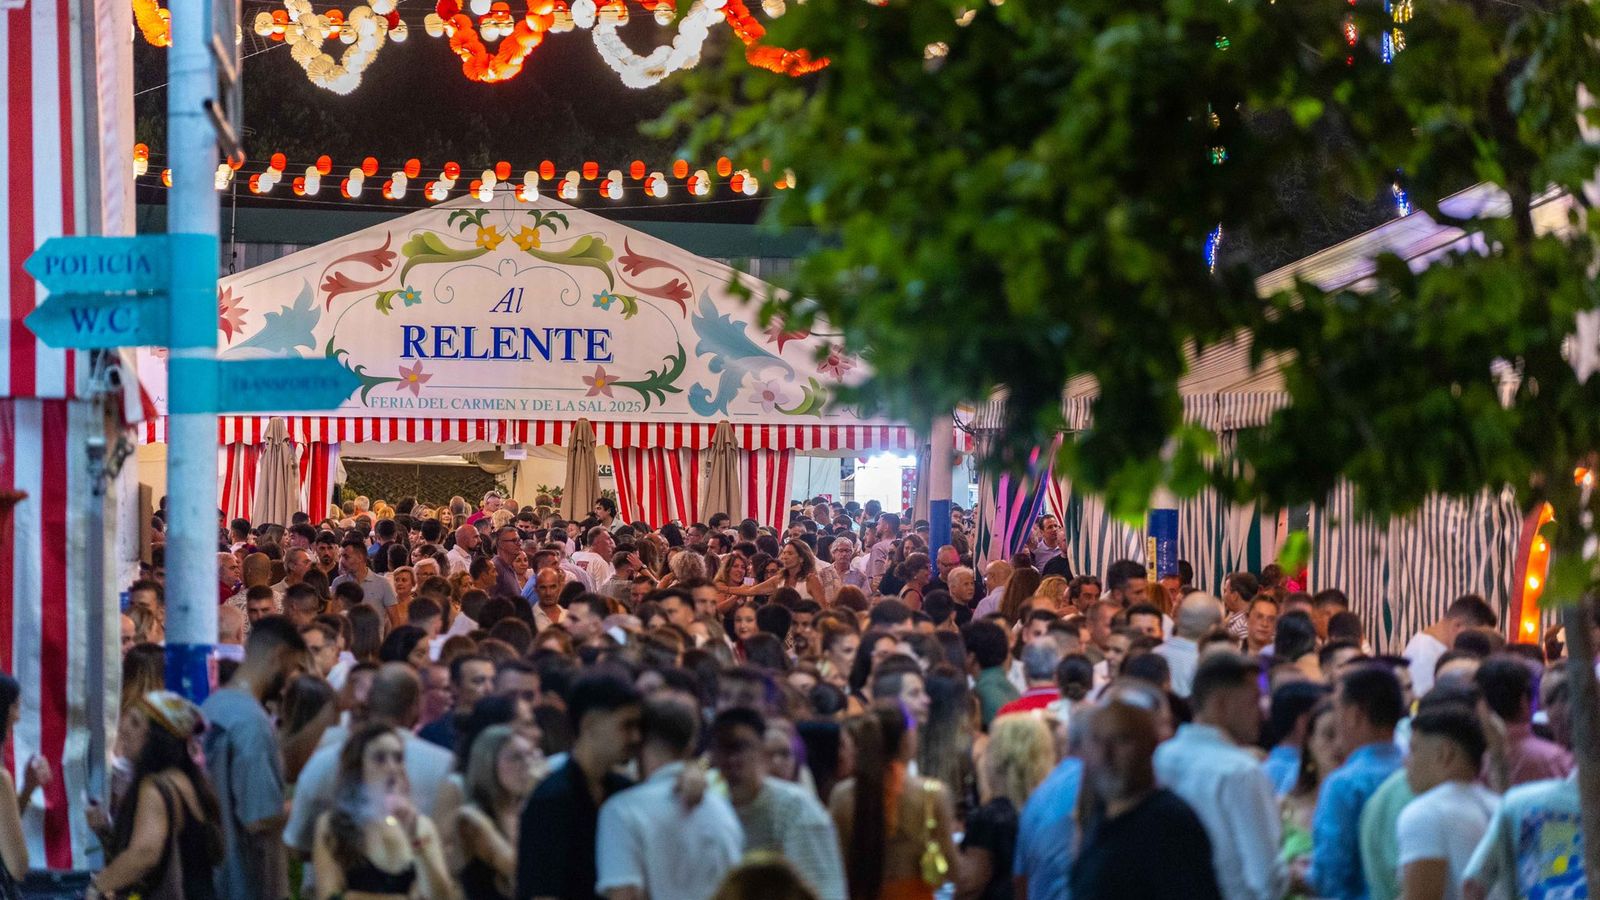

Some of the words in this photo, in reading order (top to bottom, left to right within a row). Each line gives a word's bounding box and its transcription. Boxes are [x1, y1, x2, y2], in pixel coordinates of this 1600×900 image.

[489, 287, 524, 314] Al
[69, 307, 140, 334] W.C.
[400, 325, 613, 364] RELENTE
[370, 396, 415, 409] FERIA
[418, 397, 449, 410] DEL
[451, 398, 516, 410] CARMEN
[520, 399, 530, 411] Y
[533, 399, 552, 411] DE
[557, 400, 576, 412] LA
[578, 400, 606, 412] SAL
[609, 400, 641, 413] 2025
